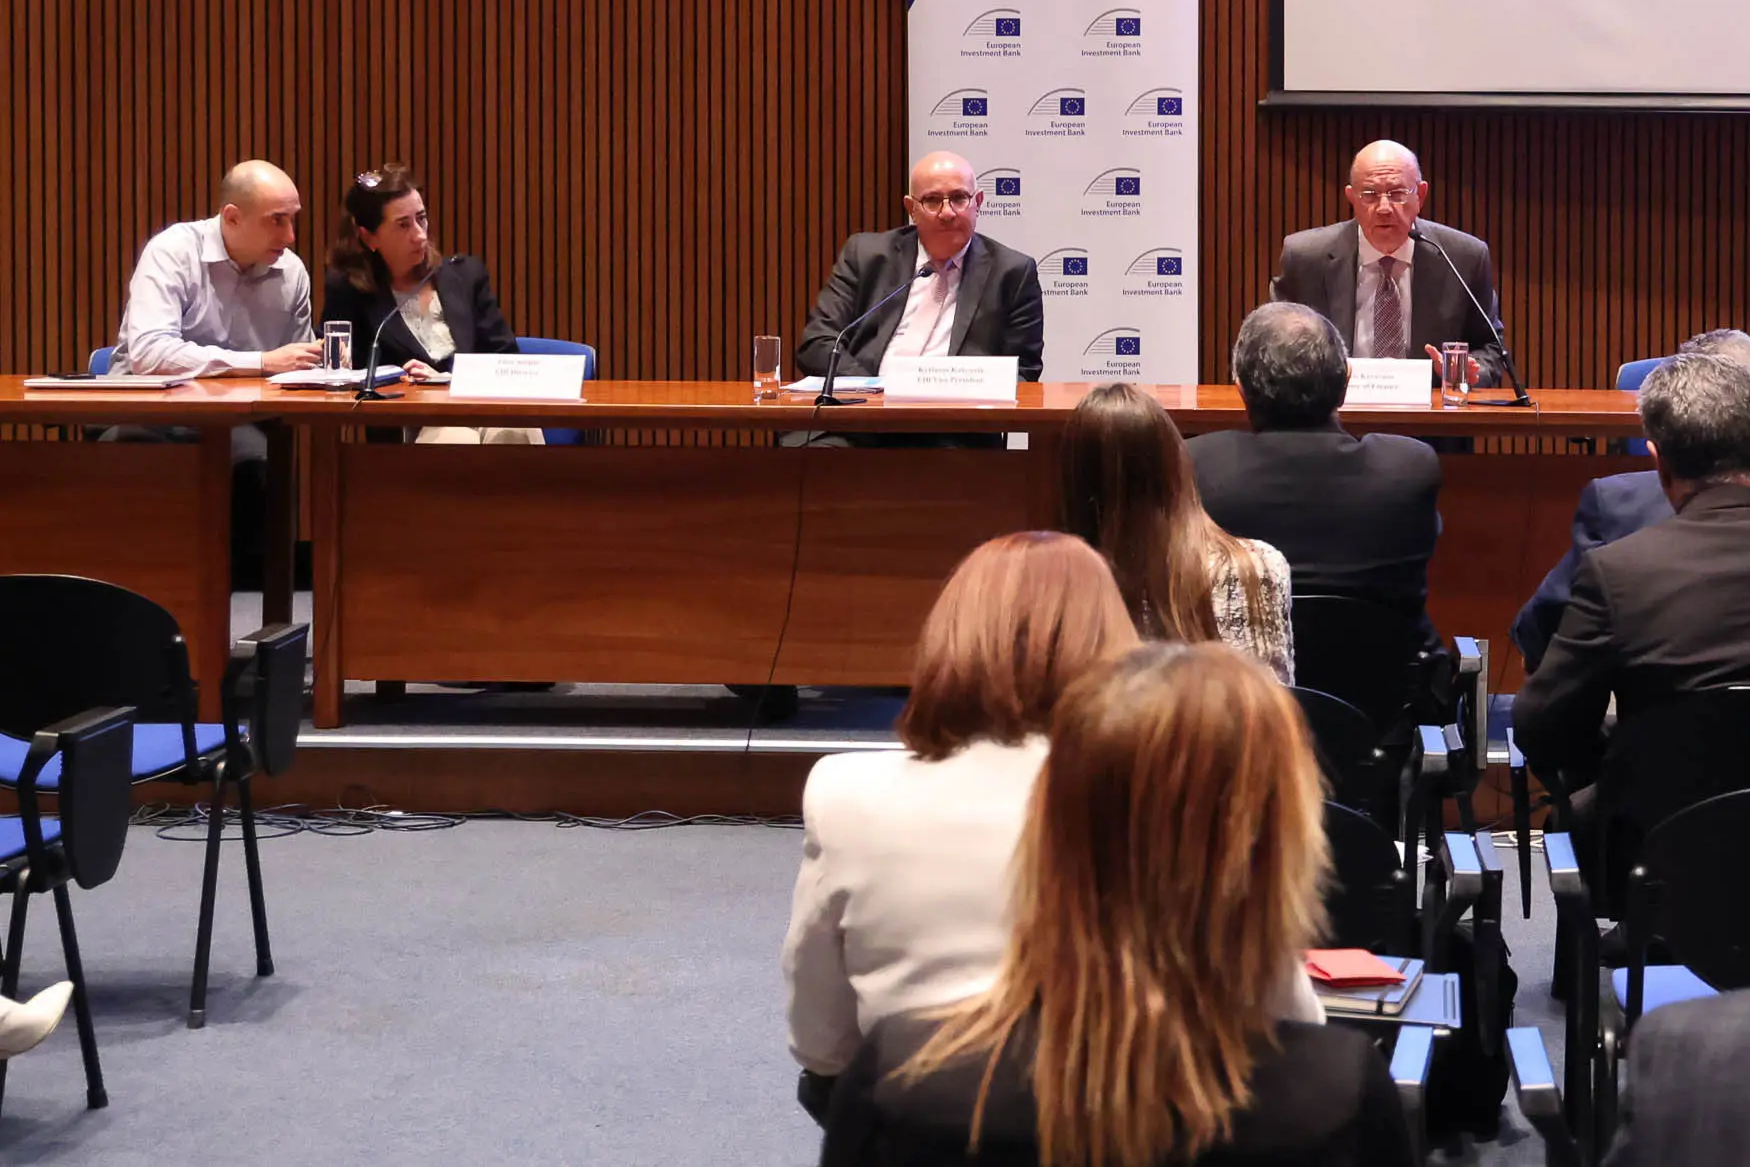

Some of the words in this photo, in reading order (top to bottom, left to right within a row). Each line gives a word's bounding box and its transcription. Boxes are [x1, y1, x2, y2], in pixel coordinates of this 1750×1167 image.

[987, 41, 1021, 51] European
[1107, 41, 1141, 51] European
[961, 49, 1001, 57] Investment
[1003, 49, 1021, 57] Bank
[1082, 49, 1121, 57] Investment
[1123, 49, 1141, 57] Bank
[954, 120, 988, 130] European
[1051, 120, 1085, 130] European
[1148, 120, 1182, 130] European
[928, 128, 969, 136] Investment
[970, 128, 988, 136] Bank
[1025, 128, 1066, 136] Investment
[1067, 128, 1085, 136] Bank
[1123, 128, 1163, 136] Investment
[1164, 128, 1182, 136] Bank
[987, 201, 1021, 211] European
[1106, 201, 1140, 211] European
[1003, 209, 1021, 217] Bank
[1081, 209, 1121, 217] Investment
[1122, 209, 1140, 217] Bank
[1054, 280, 1088, 290] European
[1148, 280, 1182, 290] European
[1070, 288, 1088, 296] Bank
[1123, 288, 1162, 296] Investment
[1164, 288, 1182, 296] Bank
[1106, 360, 1140, 370] European
[1081, 368, 1121, 376] Investment
[1122, 368, 1140, 376] Bank
